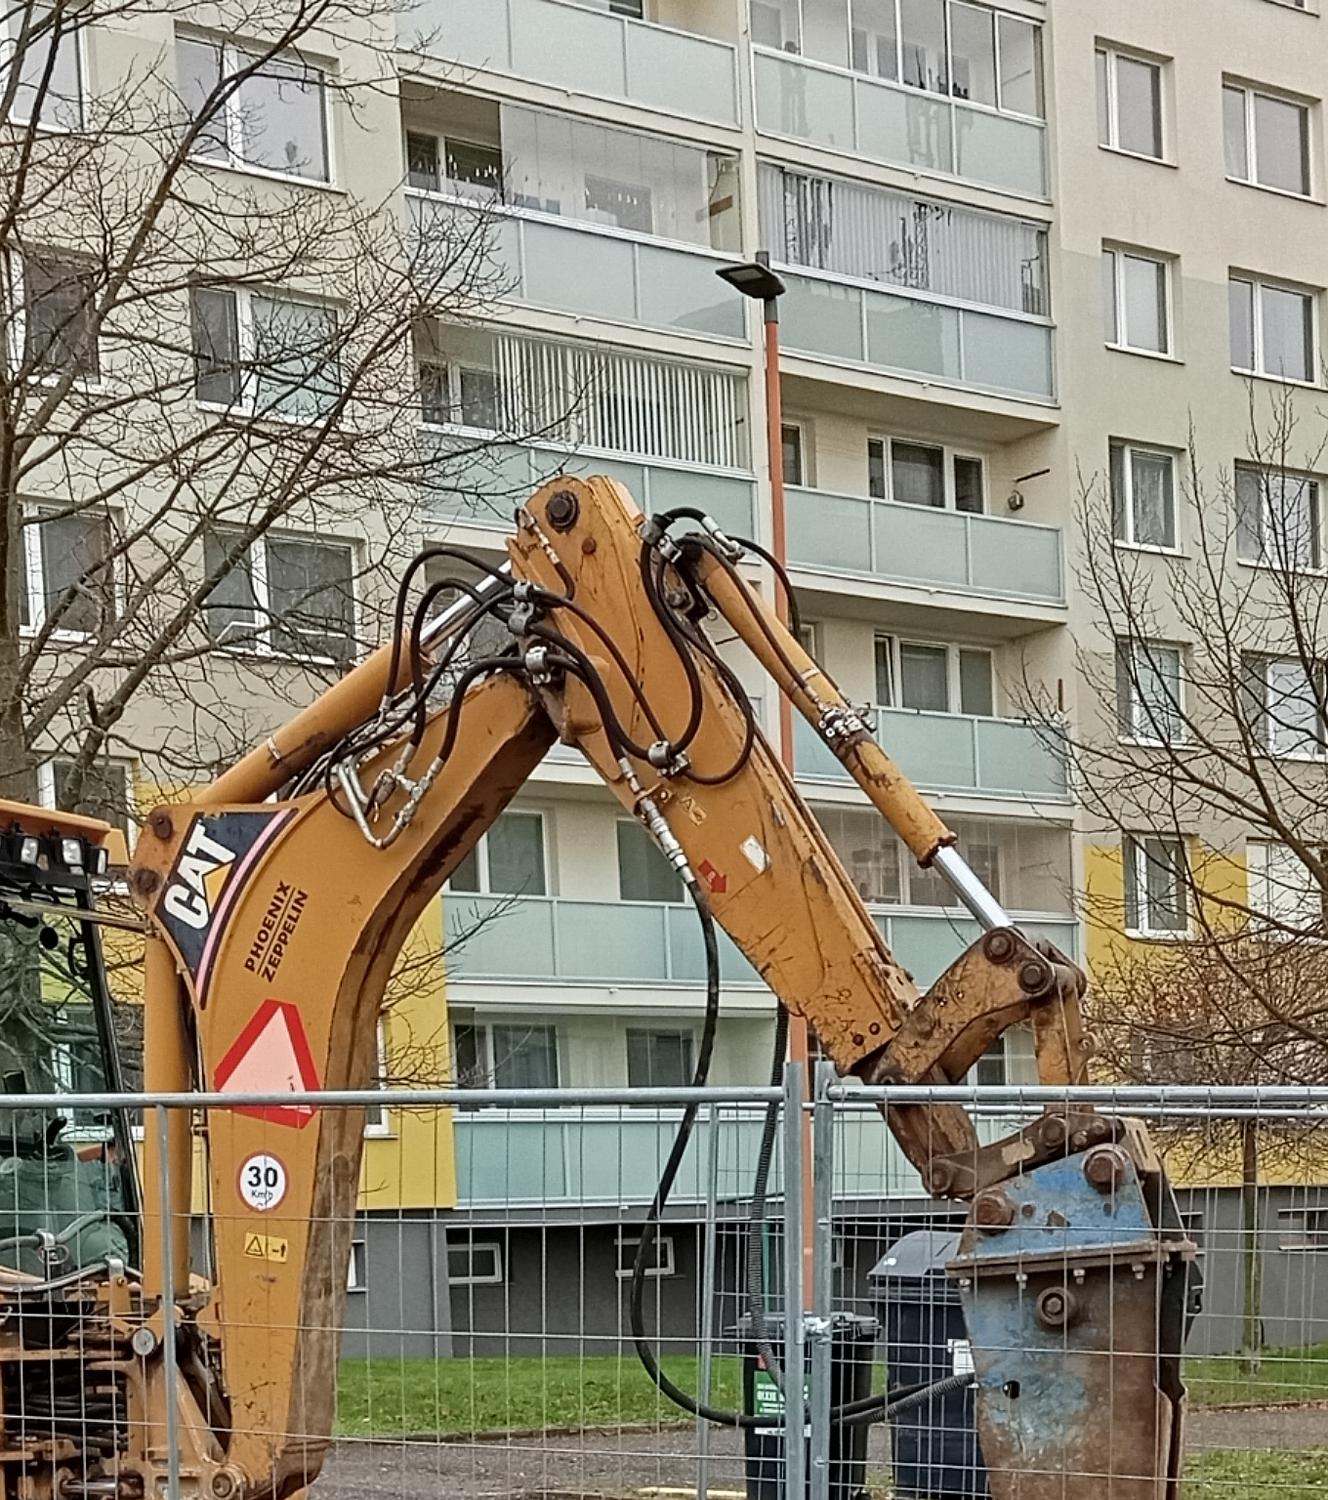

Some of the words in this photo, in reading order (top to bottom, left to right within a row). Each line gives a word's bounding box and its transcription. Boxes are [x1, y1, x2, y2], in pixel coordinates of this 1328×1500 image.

[164, 820, 237, 929] CAT
[244, 880, 292, 972] PHOENIX
[261, 890, 309, 983] ZEPPELIN
[248, 1166, 278, 1187] 30
